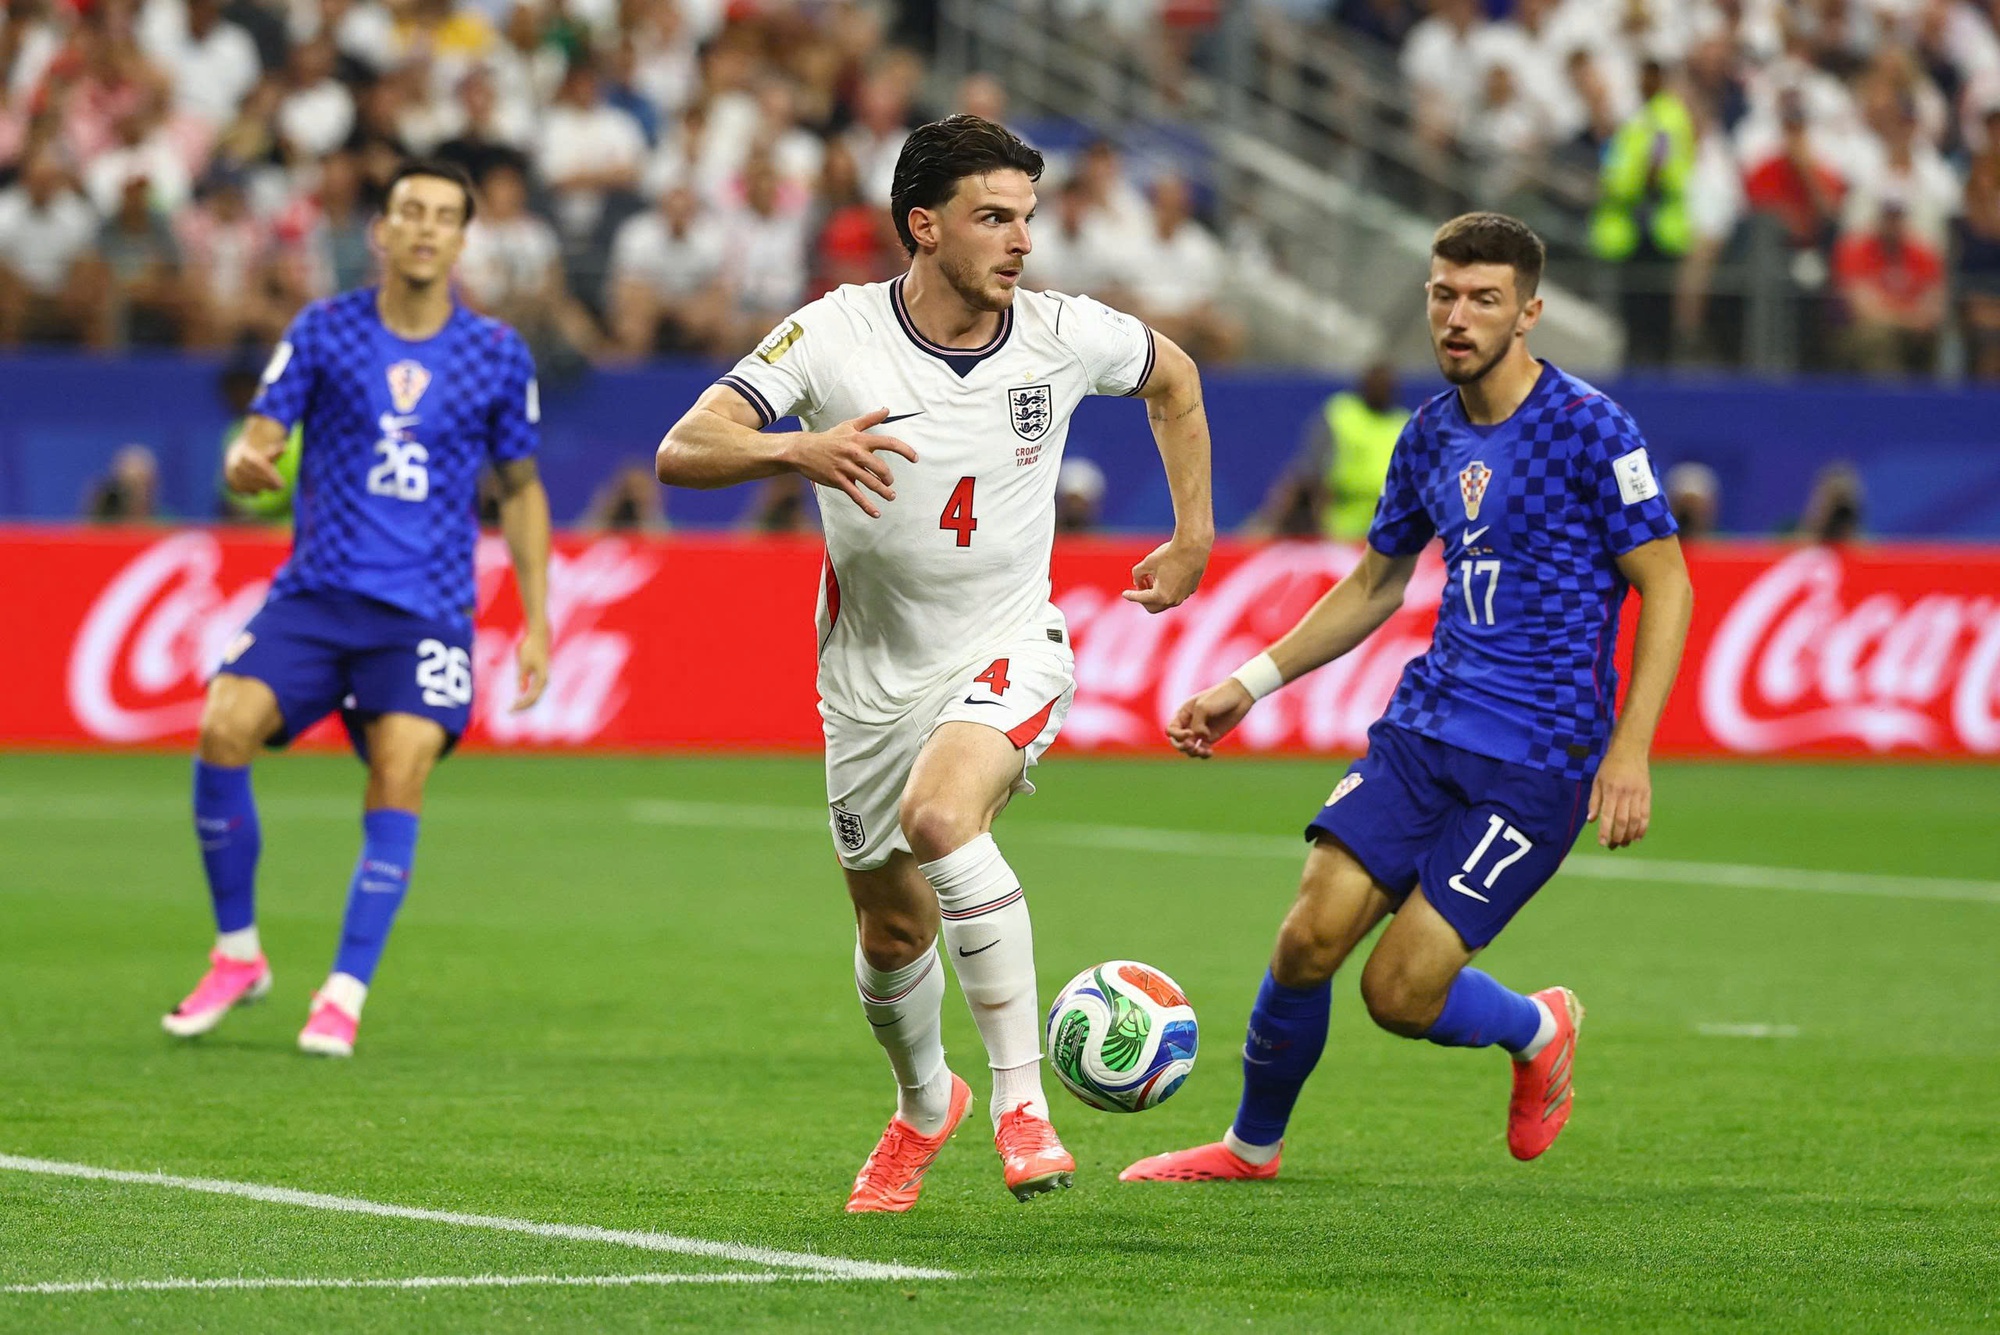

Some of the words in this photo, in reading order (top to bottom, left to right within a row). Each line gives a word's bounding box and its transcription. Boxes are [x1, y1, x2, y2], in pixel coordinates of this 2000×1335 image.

[366, 439, 429, 502] 26
[1015, 444, 1043, 457] CROATIA
[939, 476, 978, 548] 4
[1460, 560, 1501, 626] 17
[416, 638, 473, 708] 26
[973, 658, 1011, 697] 4
[1462, 813, 1533, 889] 17
[1057, 1018, 1074, 1061] TRIONDA
